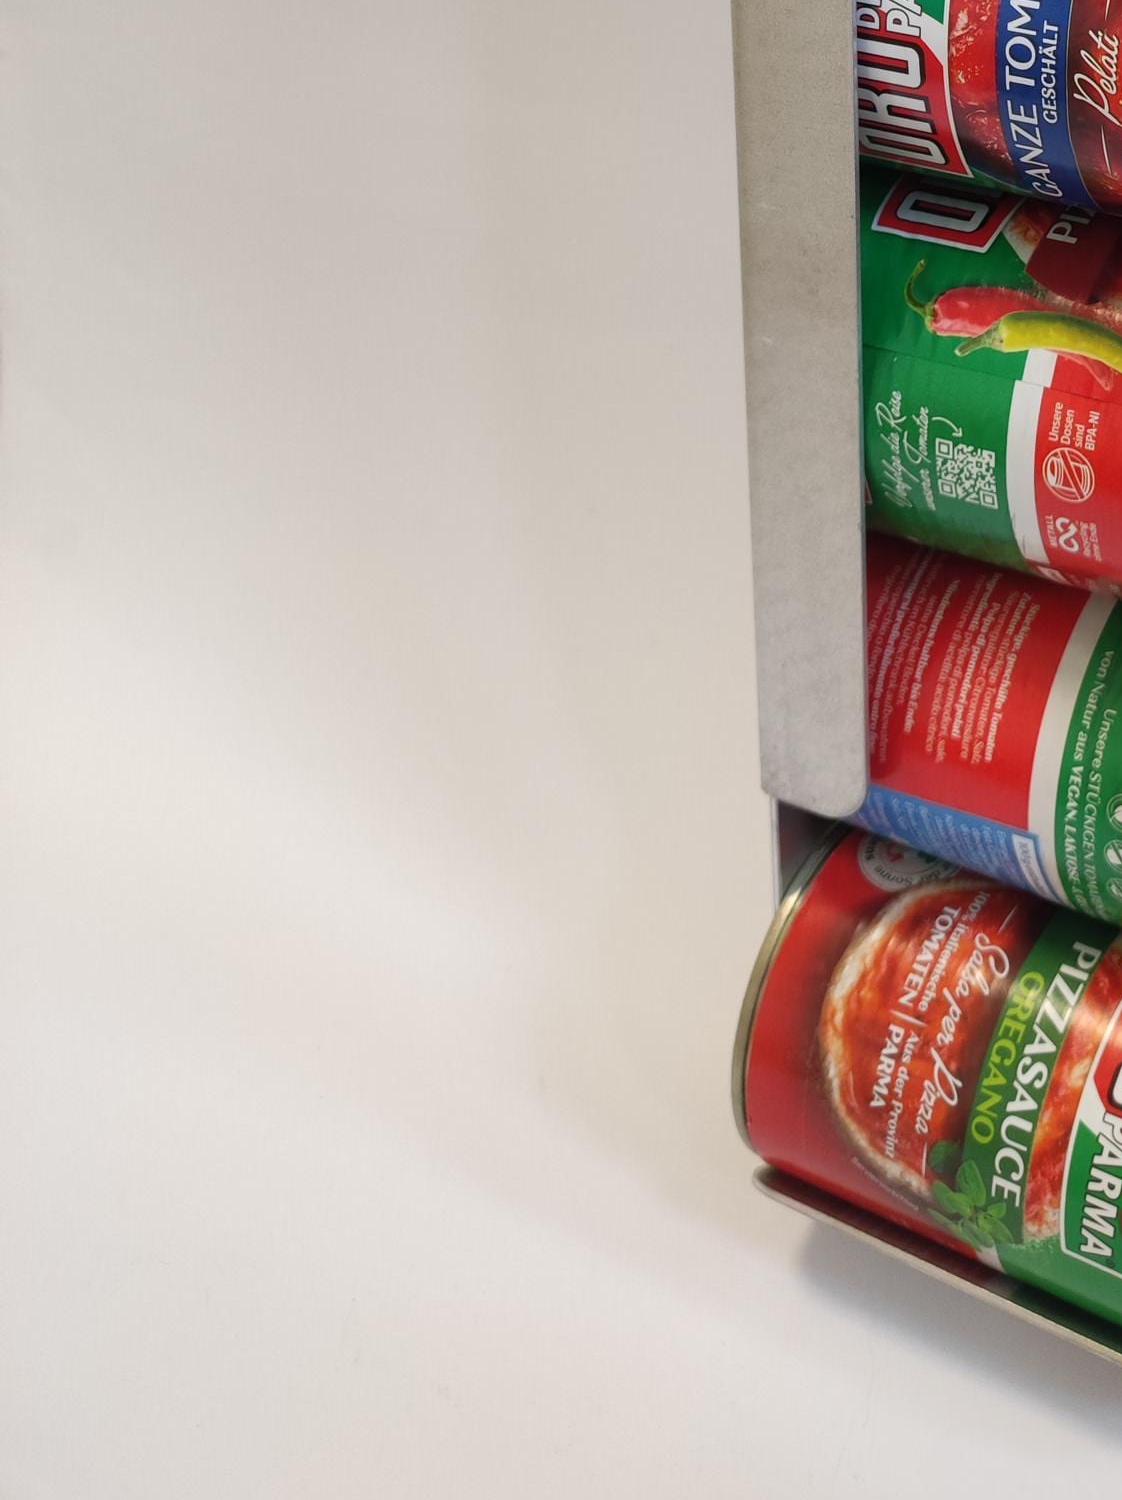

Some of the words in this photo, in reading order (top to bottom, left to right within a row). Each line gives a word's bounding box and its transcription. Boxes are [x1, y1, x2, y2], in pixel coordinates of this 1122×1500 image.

[1038, 20, 1061, 124] GESCHÄLT
[1010, 99, 1064, 198] GANZE
[875, 390, 907, 433] Reise
[902, 406, 932, 465] Tomaten
[1047, 401, 1064, 442] Unsere
[1059, 409, 1076, 446] Dosen
[1073, 423, 1086, 449] sind
[1084, 410, 1102, 451] BPA-NI
[880, 432, 901, 455] die
[1044, 514, 1059, 548] METALL
[975, 633, 988, 646] di
[1095, 649, 1116, 679] von
[908, 683, 923, 700] bis
[953, 665, 966, 677] di
[956, 646, 984, 704] pomodori
[993, 652, 1019, 710] geschälte
[929, 683, 947, 715] acido
[950, 703, 967, 740] pelati
[959, 676, 986, 759] Citronensäure
[1081, 680, 1106, 730] Natur
[925, 716, 941, 753] citrico
[984, 710, 1003, 762] Tomaten
[1072, 731, 1089, 761] aus
[1090, 707, 1118, 769] Unsere
[1063, 765, 1085, 822] VEGAN,
[1082, 770, 1107, 861] STÜCKIGEN
[962, 890, 991, 921] 100%
[898, 905, 962, 1007] TOMATEN
[917, 923, 970, 1012] italienische
[954, 932, 1011, 998] Salsa
[935, 987, 963, 1047] per
[868, 1023, 905, 1108] PARMA
[900, 1031, 921, 1063] Aus
[970, 970, 1045, 1145] OREGANO
[893, 1065, 911, 1098] der
[914, 1046, 963, 1135] Pizza
[990, 941, 1103, 1208] PIZZASAUCE
[884, 1098, 904, 1159] Provinz
